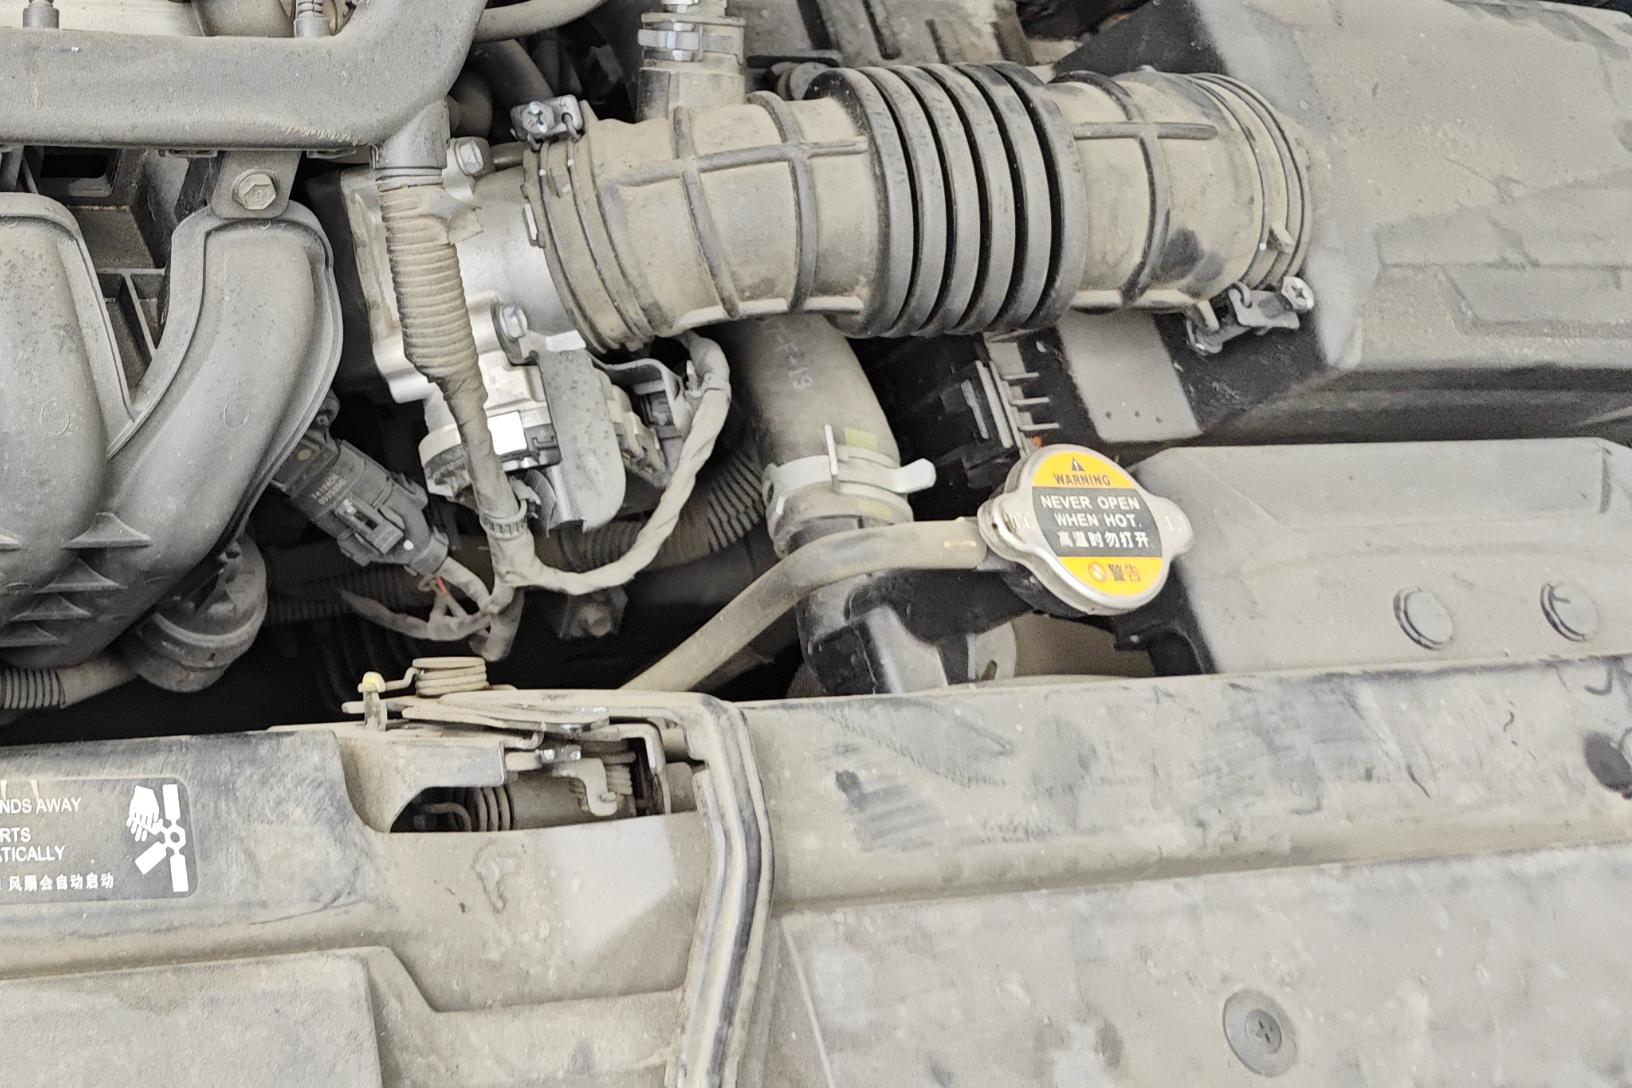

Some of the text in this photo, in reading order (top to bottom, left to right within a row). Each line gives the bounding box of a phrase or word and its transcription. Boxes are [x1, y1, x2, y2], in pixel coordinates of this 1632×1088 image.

[1053, 473, 1111, 487] WARNING
[1040, 494, 1140, 511] NEVER OPEN
[1054, 513, 1143, 528] WHEN HOT.
[36, 797, 82, 813] AWAY
